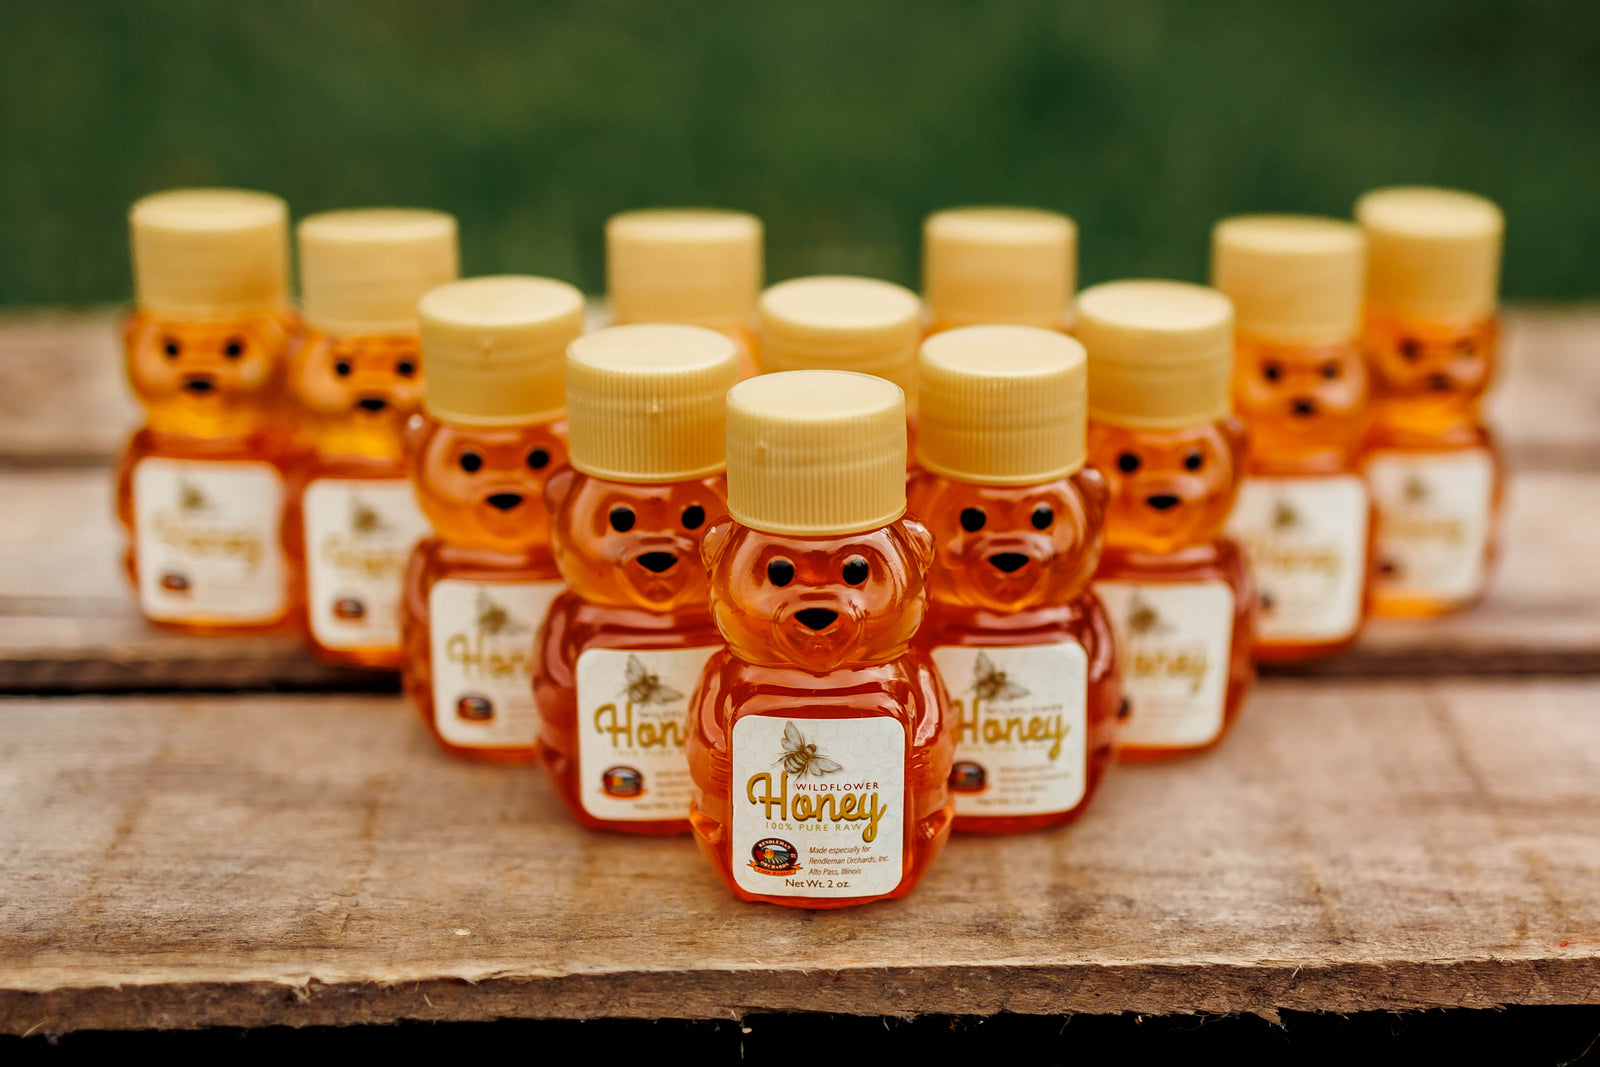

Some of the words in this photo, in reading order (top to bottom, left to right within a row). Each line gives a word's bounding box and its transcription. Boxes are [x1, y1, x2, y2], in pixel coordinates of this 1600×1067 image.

[446, 632, 532, 680] Hon
[593, 701, 686, 748] Hon
[795, 781, 879, 792] WILDFLOWER
[746, 771, 888, 843] Honey
[765, 822, 793, 831] 100%
[799, 823, 829, 832] PURE
[835, 822, 863, 832] RAW
[808, 846, 828, 854] Made
[828, 845, 861, 855] especially
[861, 845, 871, 853] for
[808, 857, 846, 865] Rendleman
[808, 868, 822, 876] Alto
[822, 868, 840, 876] Pass,
[841, 867, 862, 875] Illinois
[785, 878, 805, 888] Net
[806, 879, 825, 888] Wt.
[827, 879, 834, 888] 2
[836, 880, 851, 888] oz.
